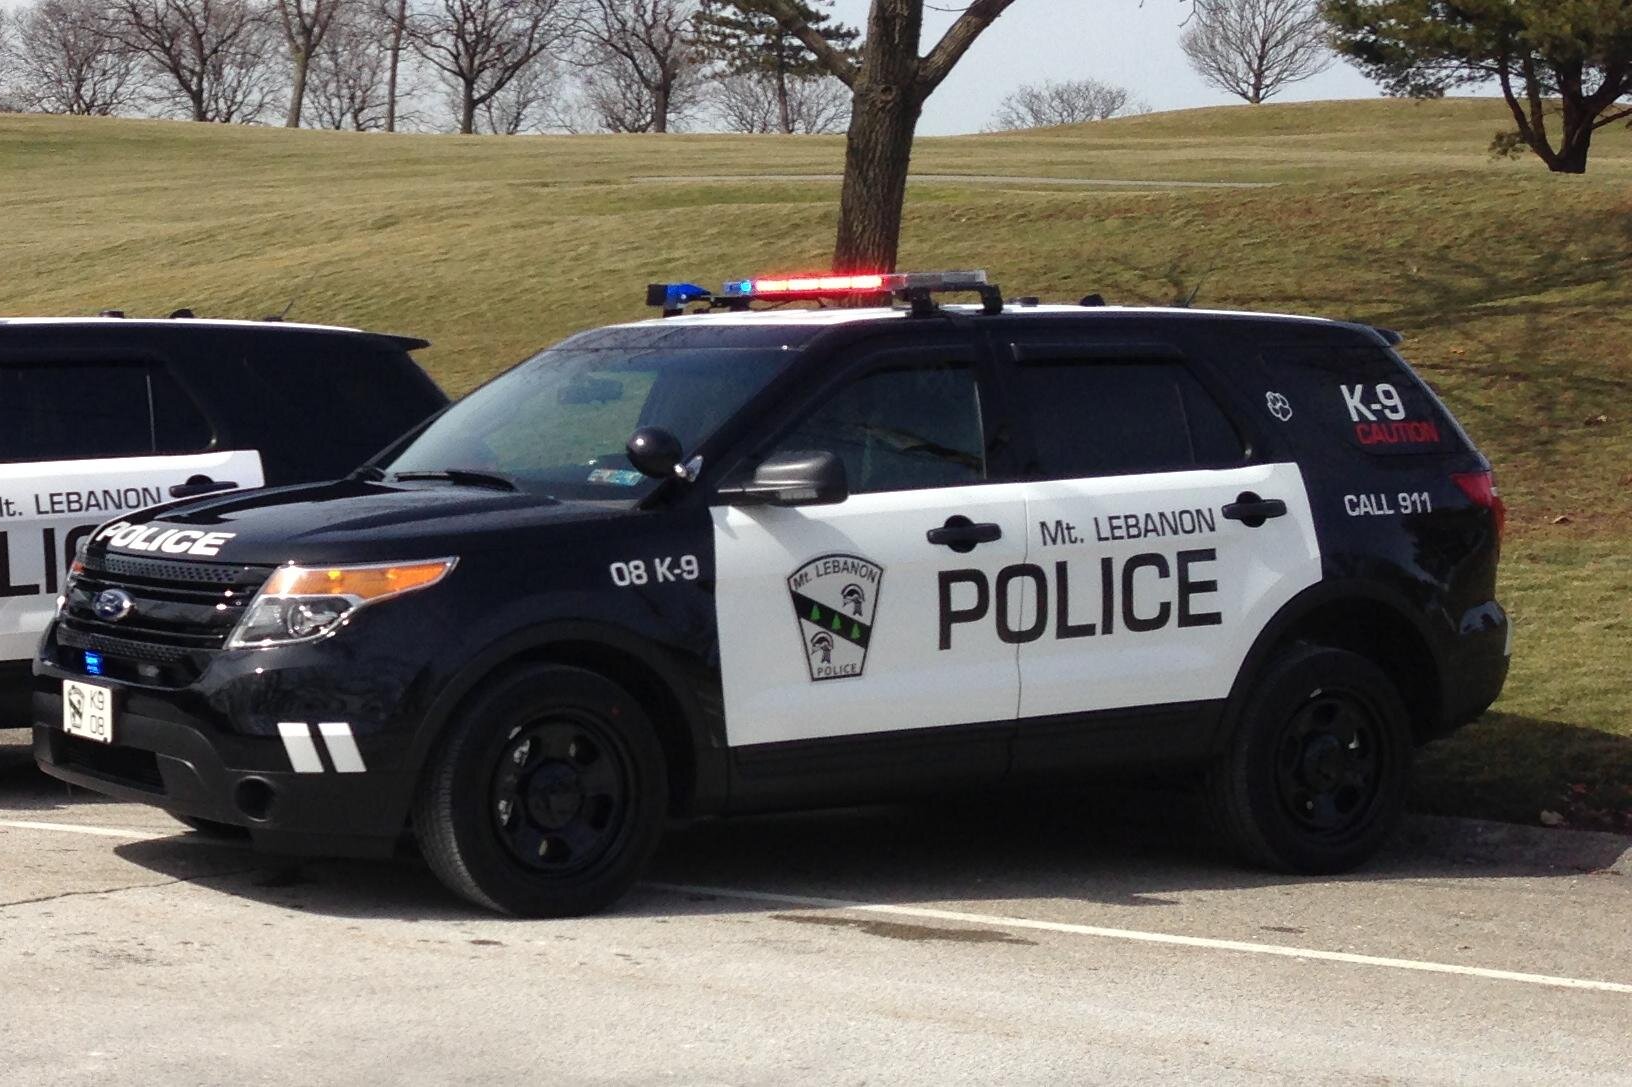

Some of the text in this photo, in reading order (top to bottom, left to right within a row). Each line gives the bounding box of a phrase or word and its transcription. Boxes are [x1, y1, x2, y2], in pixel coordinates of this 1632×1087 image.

[1340, 383, 1406, 422] K-9
[1355, 421, 1440, 445] CAUTION
[35, 487, 162, 516] LEBANON
[1344, 491, 1433, 516] CALL 911
[96, 521, 237, 556] POLICE
[1040, 508, 1216, 546] Mt. LEBANON
[610, 554, 699, 587] 08 K-9
[792, 559, 878, 591] Mt. LEBANON
[938, 548, 1222, 651] POLICE
[817, 663, 858, 676] POLICE
[90, 690, 104, 711] K9
[90, 714, 104, 736] 08
